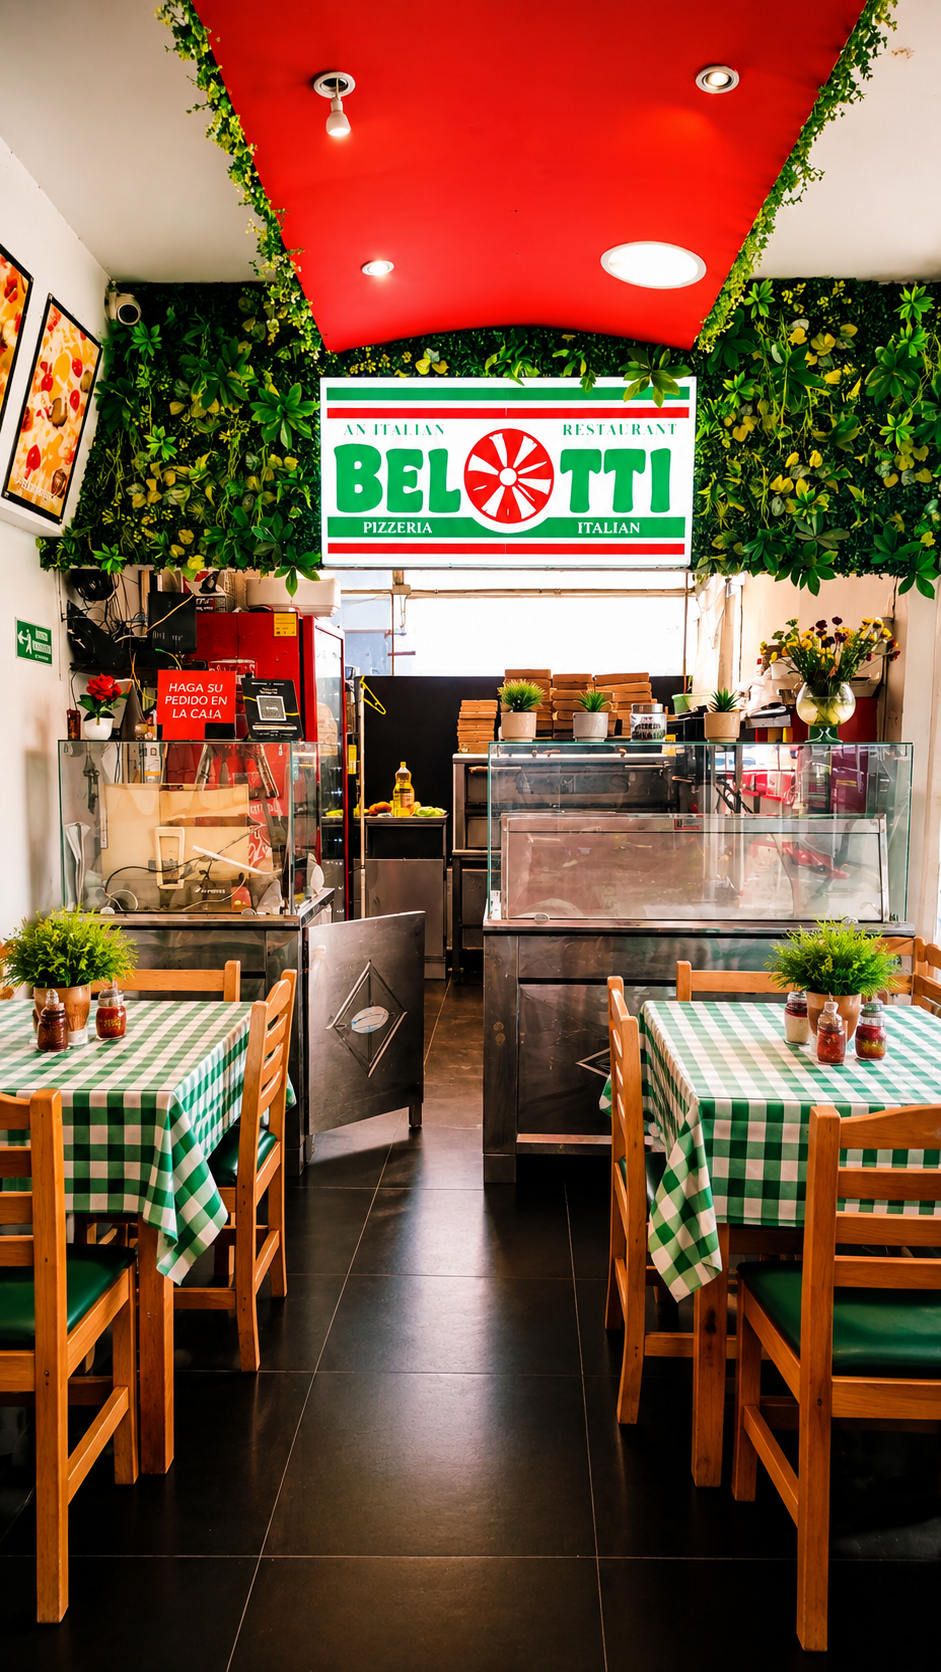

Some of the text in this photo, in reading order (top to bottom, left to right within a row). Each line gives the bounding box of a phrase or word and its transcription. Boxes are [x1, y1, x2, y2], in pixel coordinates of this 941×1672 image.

[343, 423, 445, 436] AN ITALIAN
[562, 423, 678, 436] RESTAURANT
[363, 521, 433, 534] PIZZERIA
[577, 521, 641, 534] ITALIAN
[168, 682, 224, 693] HAGA SU
[164, 695, 228, 706] PEDIDO EN
[172, 708, 188, 719] LA
